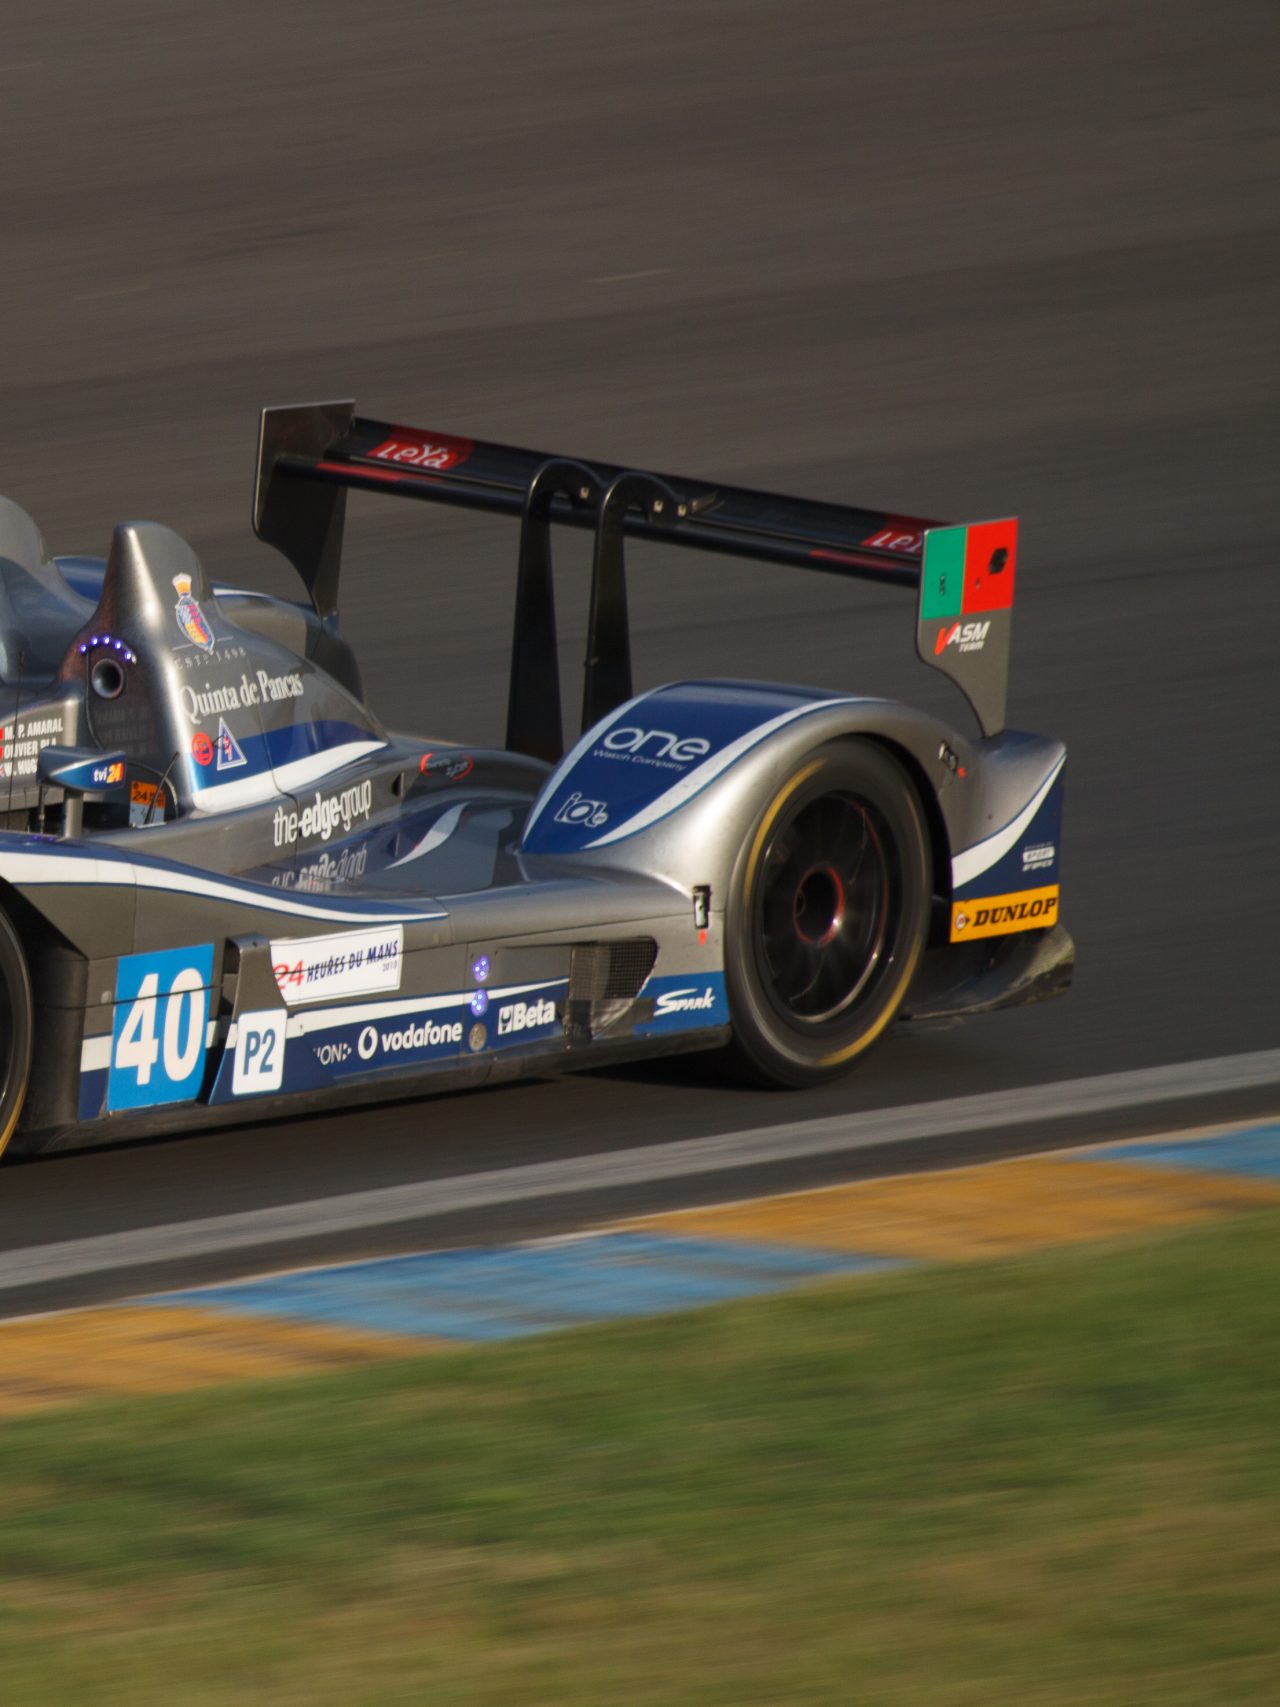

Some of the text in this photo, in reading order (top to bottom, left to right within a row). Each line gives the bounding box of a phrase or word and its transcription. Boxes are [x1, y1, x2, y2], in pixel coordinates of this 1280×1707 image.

[178, 669, 305, 725] Quinta de Pancas
[18, 723, 25, 739] P.
[26, 717, 63, 737] AMARAL
[604, 727, 711, 761] one
[17, 758, 39, 776] HUG
[972, 897, 1057, 927] DUNLOP
[272, 940, 399, 990] 24 HEURES DU MANS
[114, 967, 205, 1086] 40
[513, 999, 556, 1030] Beta
[242, 1028, 276, 1077] P2
[381, 1019, 463, 1053] vodafone
